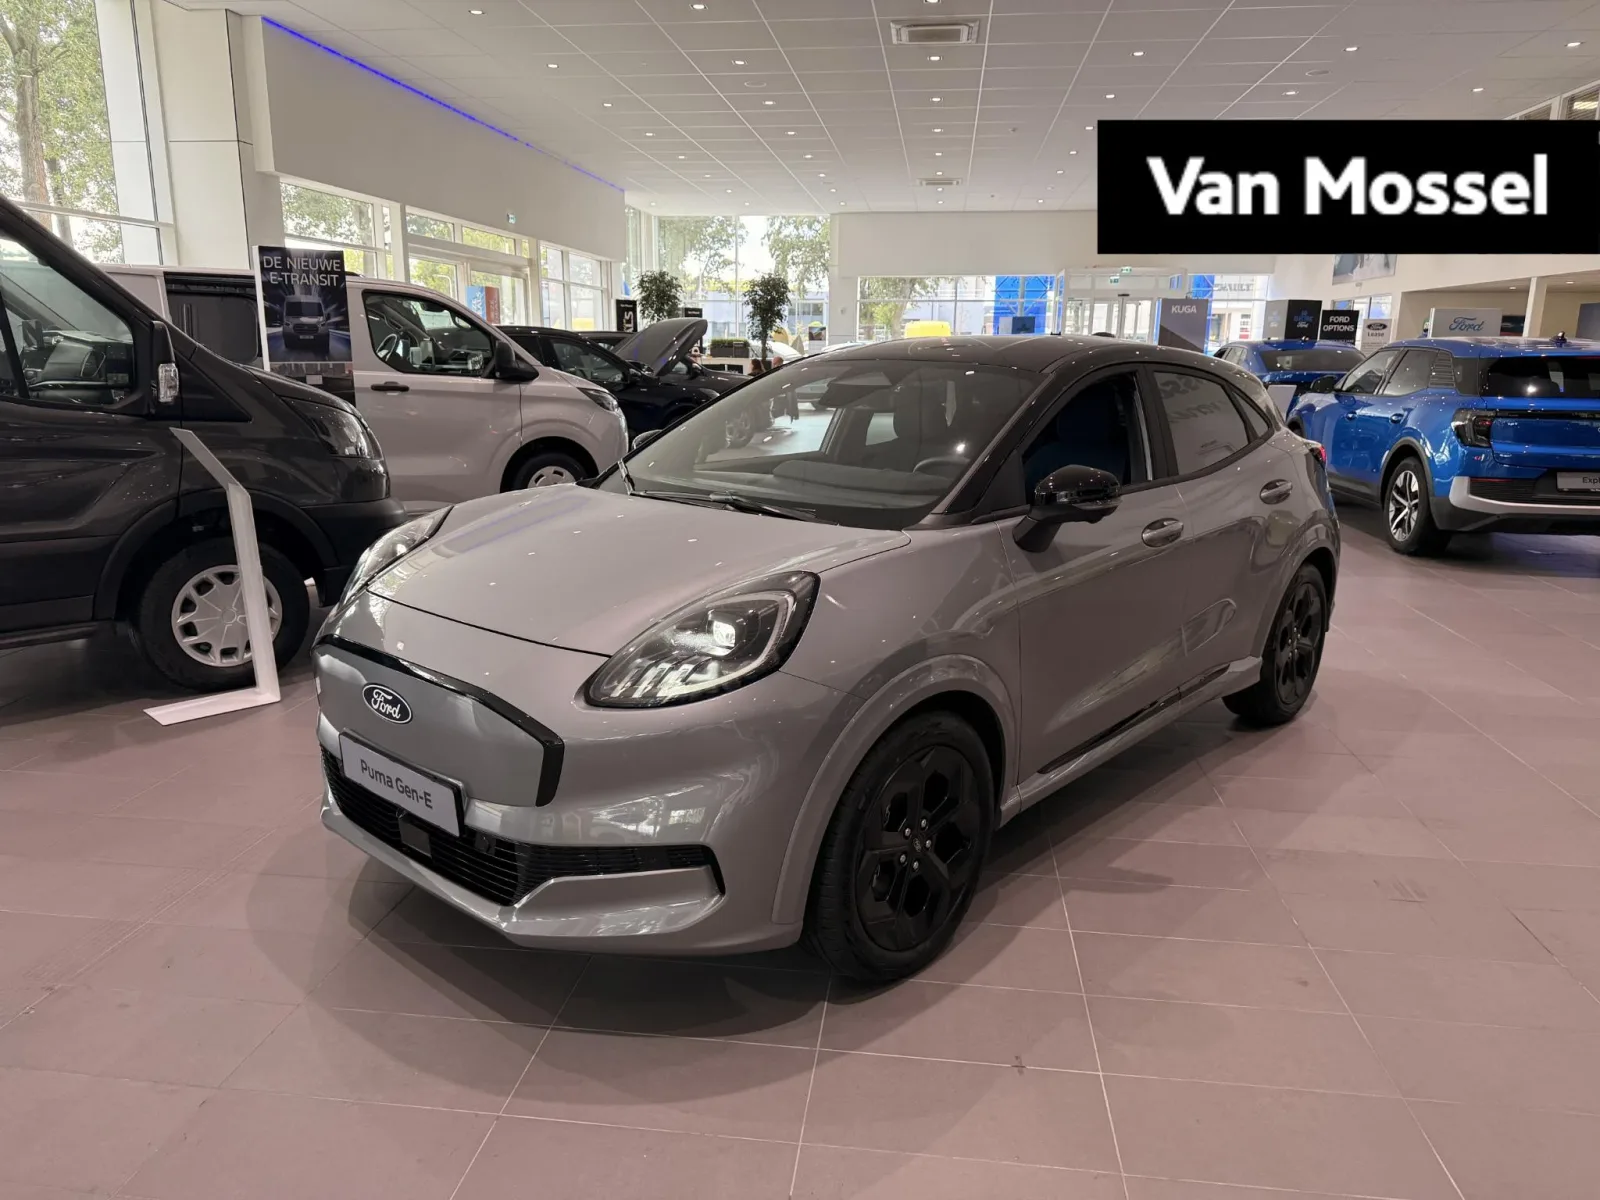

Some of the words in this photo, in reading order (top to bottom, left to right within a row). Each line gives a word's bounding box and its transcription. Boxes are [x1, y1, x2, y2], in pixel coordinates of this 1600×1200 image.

[262, 255, 282, 269] DE
[286, 257, 341, 271] NIEUWE
[269, 271, 339, 287] E-TRANSIT
[1171, 305, 1197, 314] KUGA
[1329, 315, 1350, 323] FORD
[1448, 316, 1485, 331] Ford
[1322, 324, 1355, 332] OPTIONS
[371, 688, 401, 719] Ford
[360, 759, 394, 789] Puma
[395, 778, 433, 809] Gen-E
